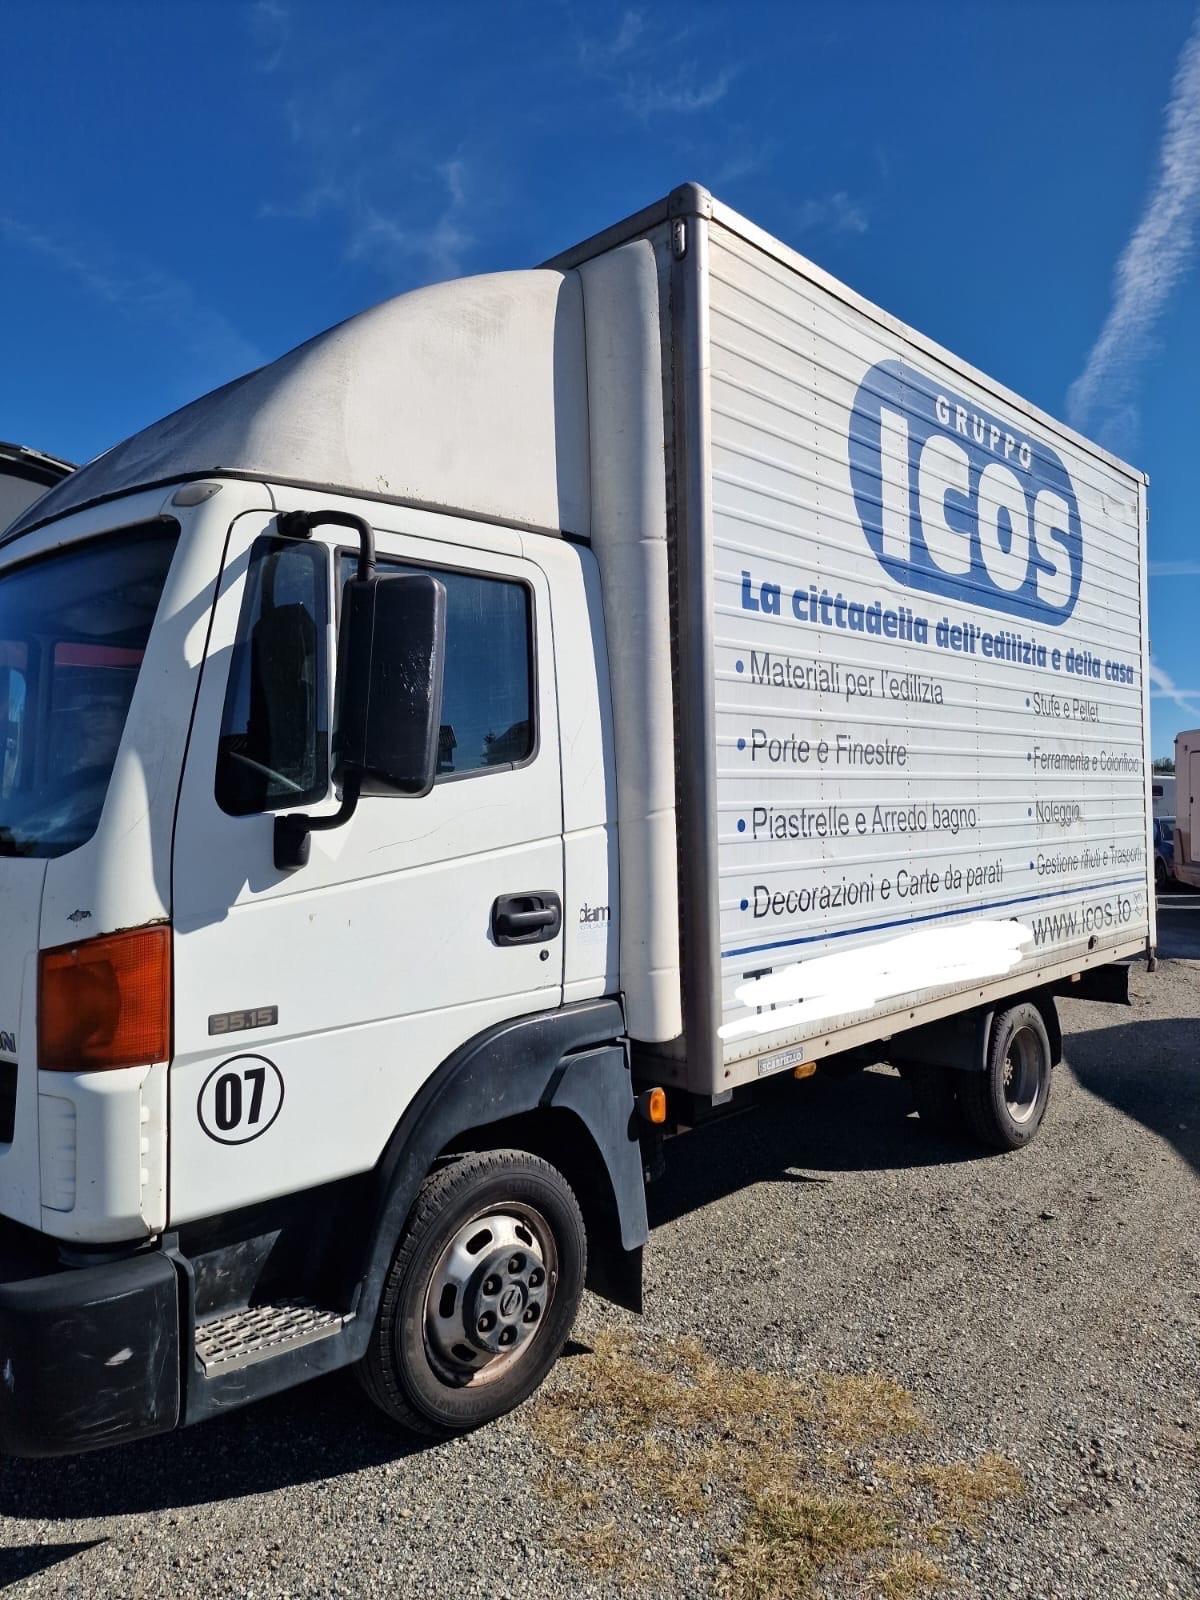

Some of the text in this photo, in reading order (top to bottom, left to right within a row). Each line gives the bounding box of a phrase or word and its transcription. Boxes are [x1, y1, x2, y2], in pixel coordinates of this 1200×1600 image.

[935, 394, 1033, 470] GRUPPO
[741, 571, 1134, 685] La cittadella dell'edilizia e della casa
[750, 650, 944, 704] Materiali per l'edilizia
[1033, 692, 1099, 722] Stufe e Pellet
[751, 728, 907, 766] Porte e Finestre
[1033, 746, 1090, 773] Ferramenta
[1092, 758, 1098, 772] e
[752, 803, 976, 840] Piastrelle e Arredo bagno
[1036, 800, 1080, 827] Noleggio
[1037, 853, 1078, 876] Gestione
[1102, 850, 1109, 866] e
[753, 858, 1004, 919] Decorazioni e Carte da parati
[1031, 894, 1132, 947] www.icos.to
[213, 1009, 272, 1033] 35.15
[215, 1067, 266, 1131] 07
